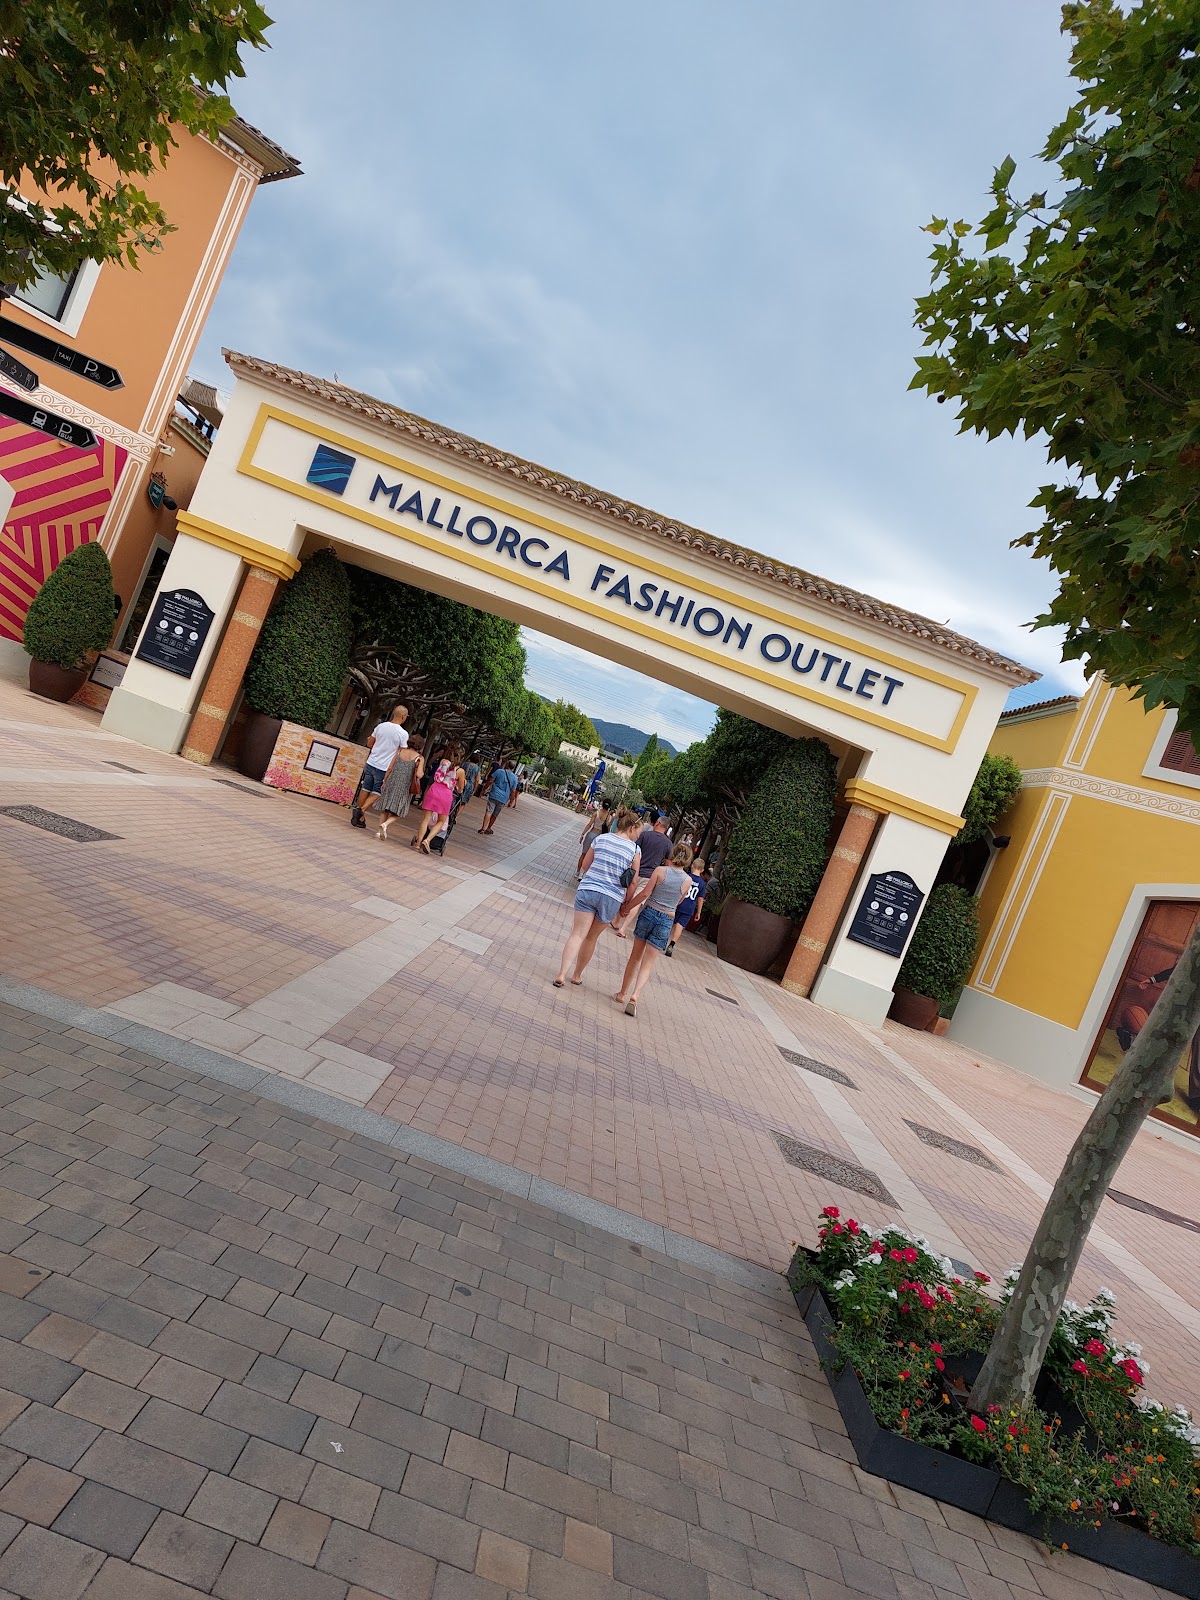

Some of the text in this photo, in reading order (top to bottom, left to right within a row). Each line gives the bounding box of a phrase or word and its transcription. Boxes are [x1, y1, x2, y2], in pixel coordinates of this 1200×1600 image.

[58, 351, 99, 374] TAXI P
[58, 422, 73, 436] P
[60, 432, 73, 442] BUS
[369, 474, 904, 705] MALLORCA FASHION OUTLET
